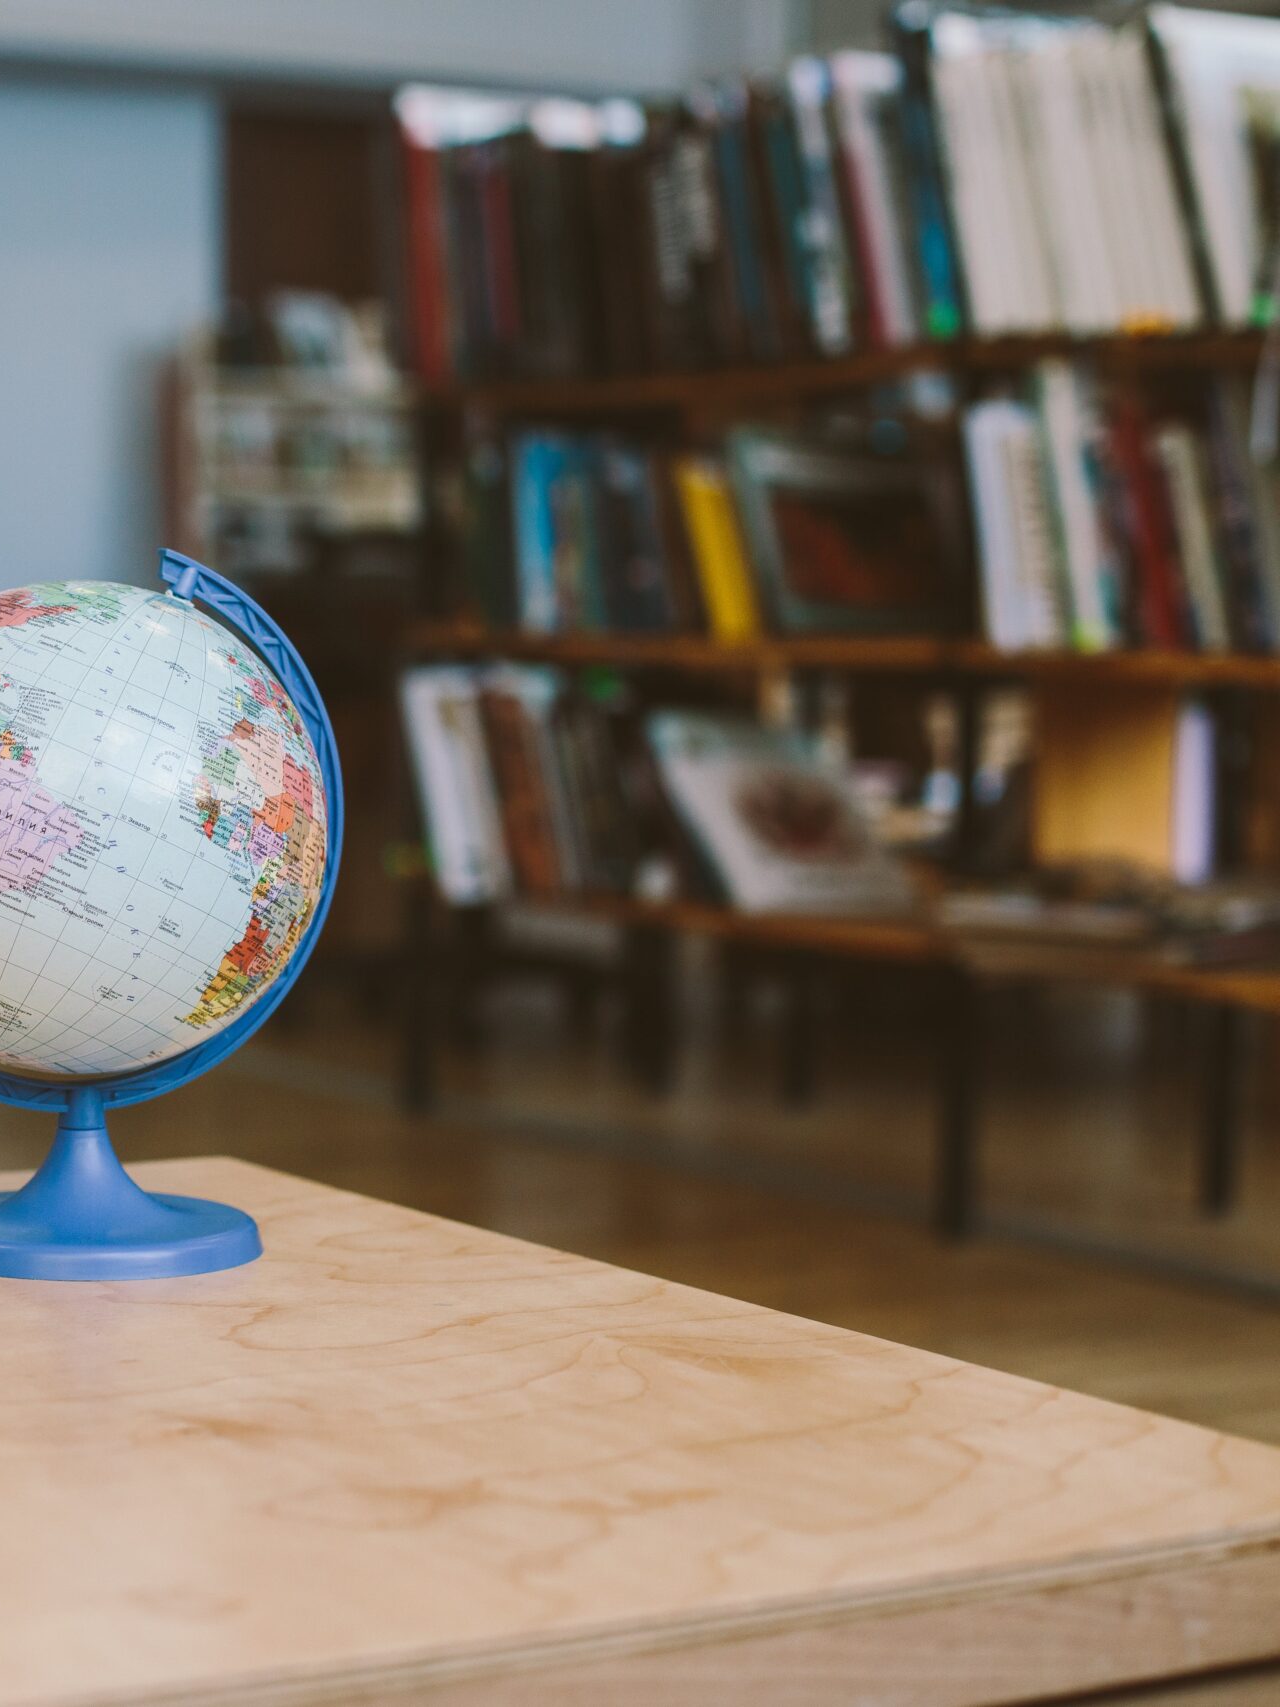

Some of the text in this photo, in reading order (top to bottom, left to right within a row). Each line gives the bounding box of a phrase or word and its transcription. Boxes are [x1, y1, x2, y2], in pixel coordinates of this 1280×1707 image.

[127, 704, 176, 731] Северный тропик
[35, 794, 50, 803] Белен
[128, 817, 151, 832] Экватор
[161, 832, 168, 840] 20
[61, 856, 88, 870] Сальвадор
[0, 890, 22, 903] Куритиба
[62, 907, 104, 929] Южный тропик
